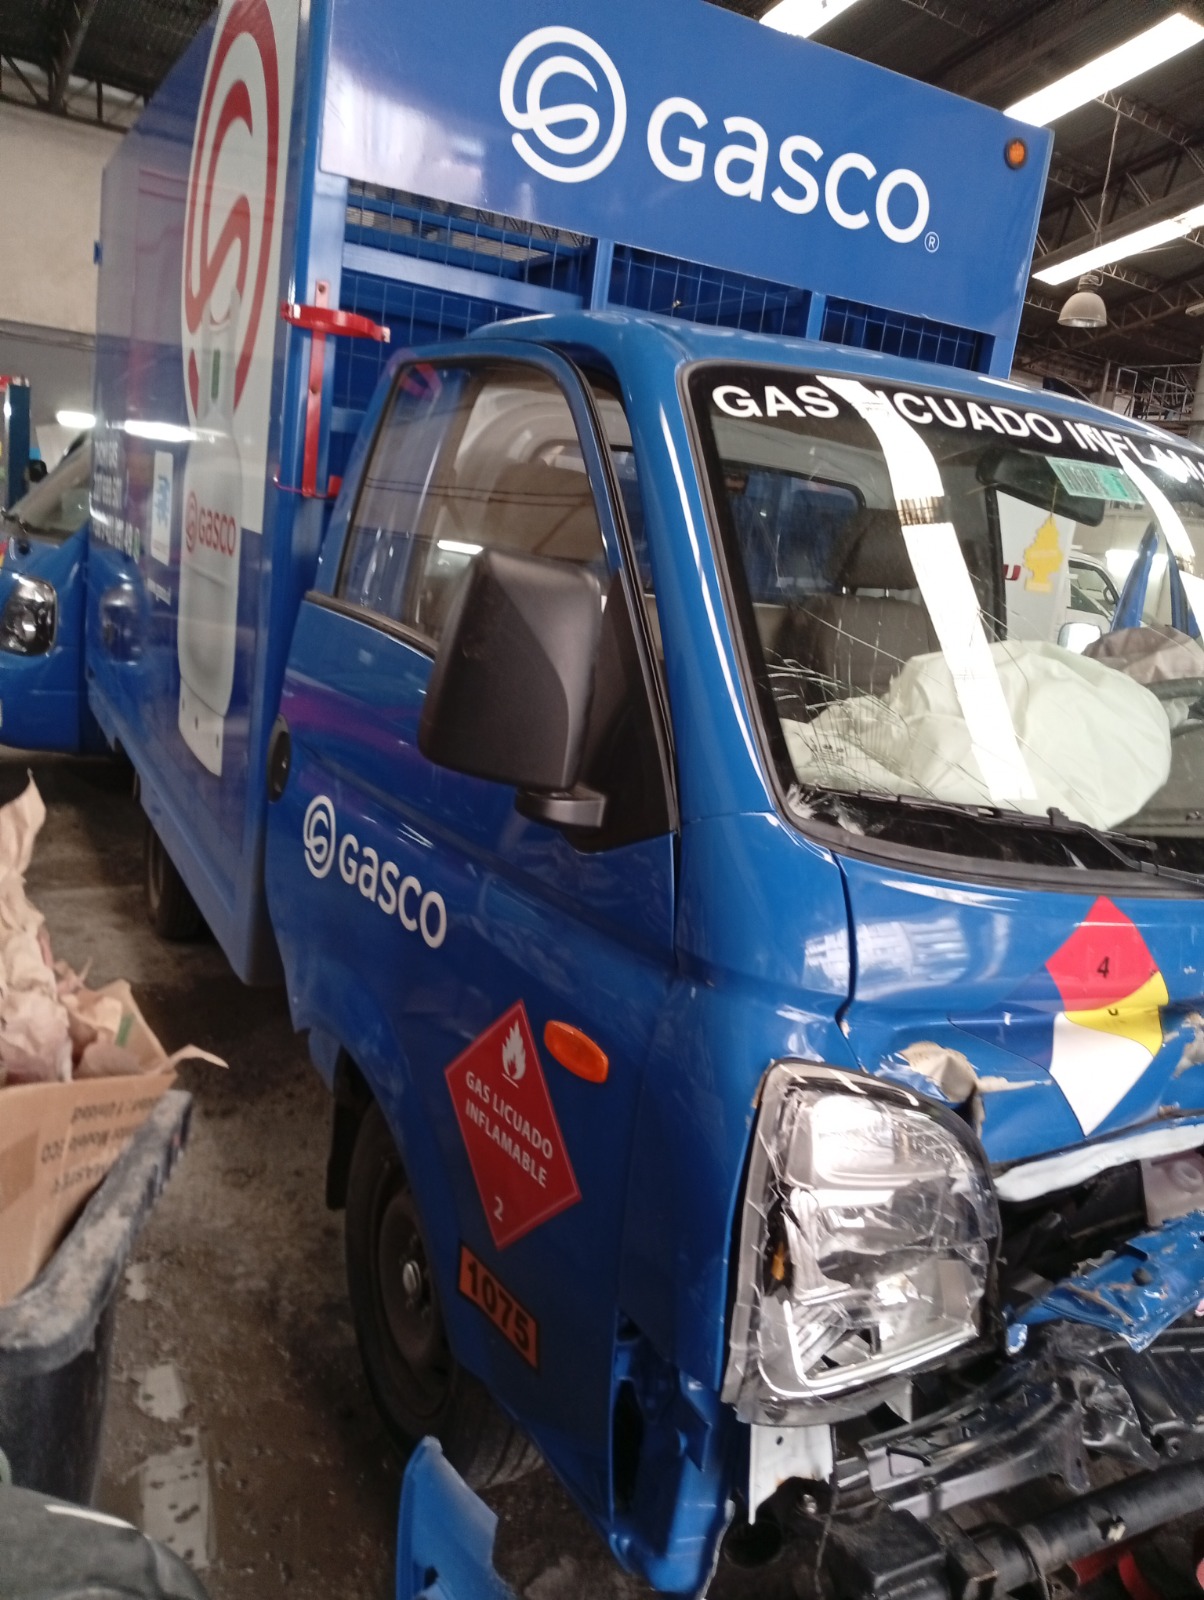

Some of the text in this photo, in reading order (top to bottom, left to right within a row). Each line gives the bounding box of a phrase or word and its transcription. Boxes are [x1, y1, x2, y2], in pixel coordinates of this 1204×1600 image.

[711, 384, 840, 419] GAS
[856, 388, 1063, 444] CUADO
[1097, 956, 1109, 977] 4
[465, 1071, 554, 1160] GAS LICUADO
[465, 1098, 548, 1189] INFLAMABLE
[493, 1195, 504, 1222] 2
[467, 1261, 530, 1353] 1075
